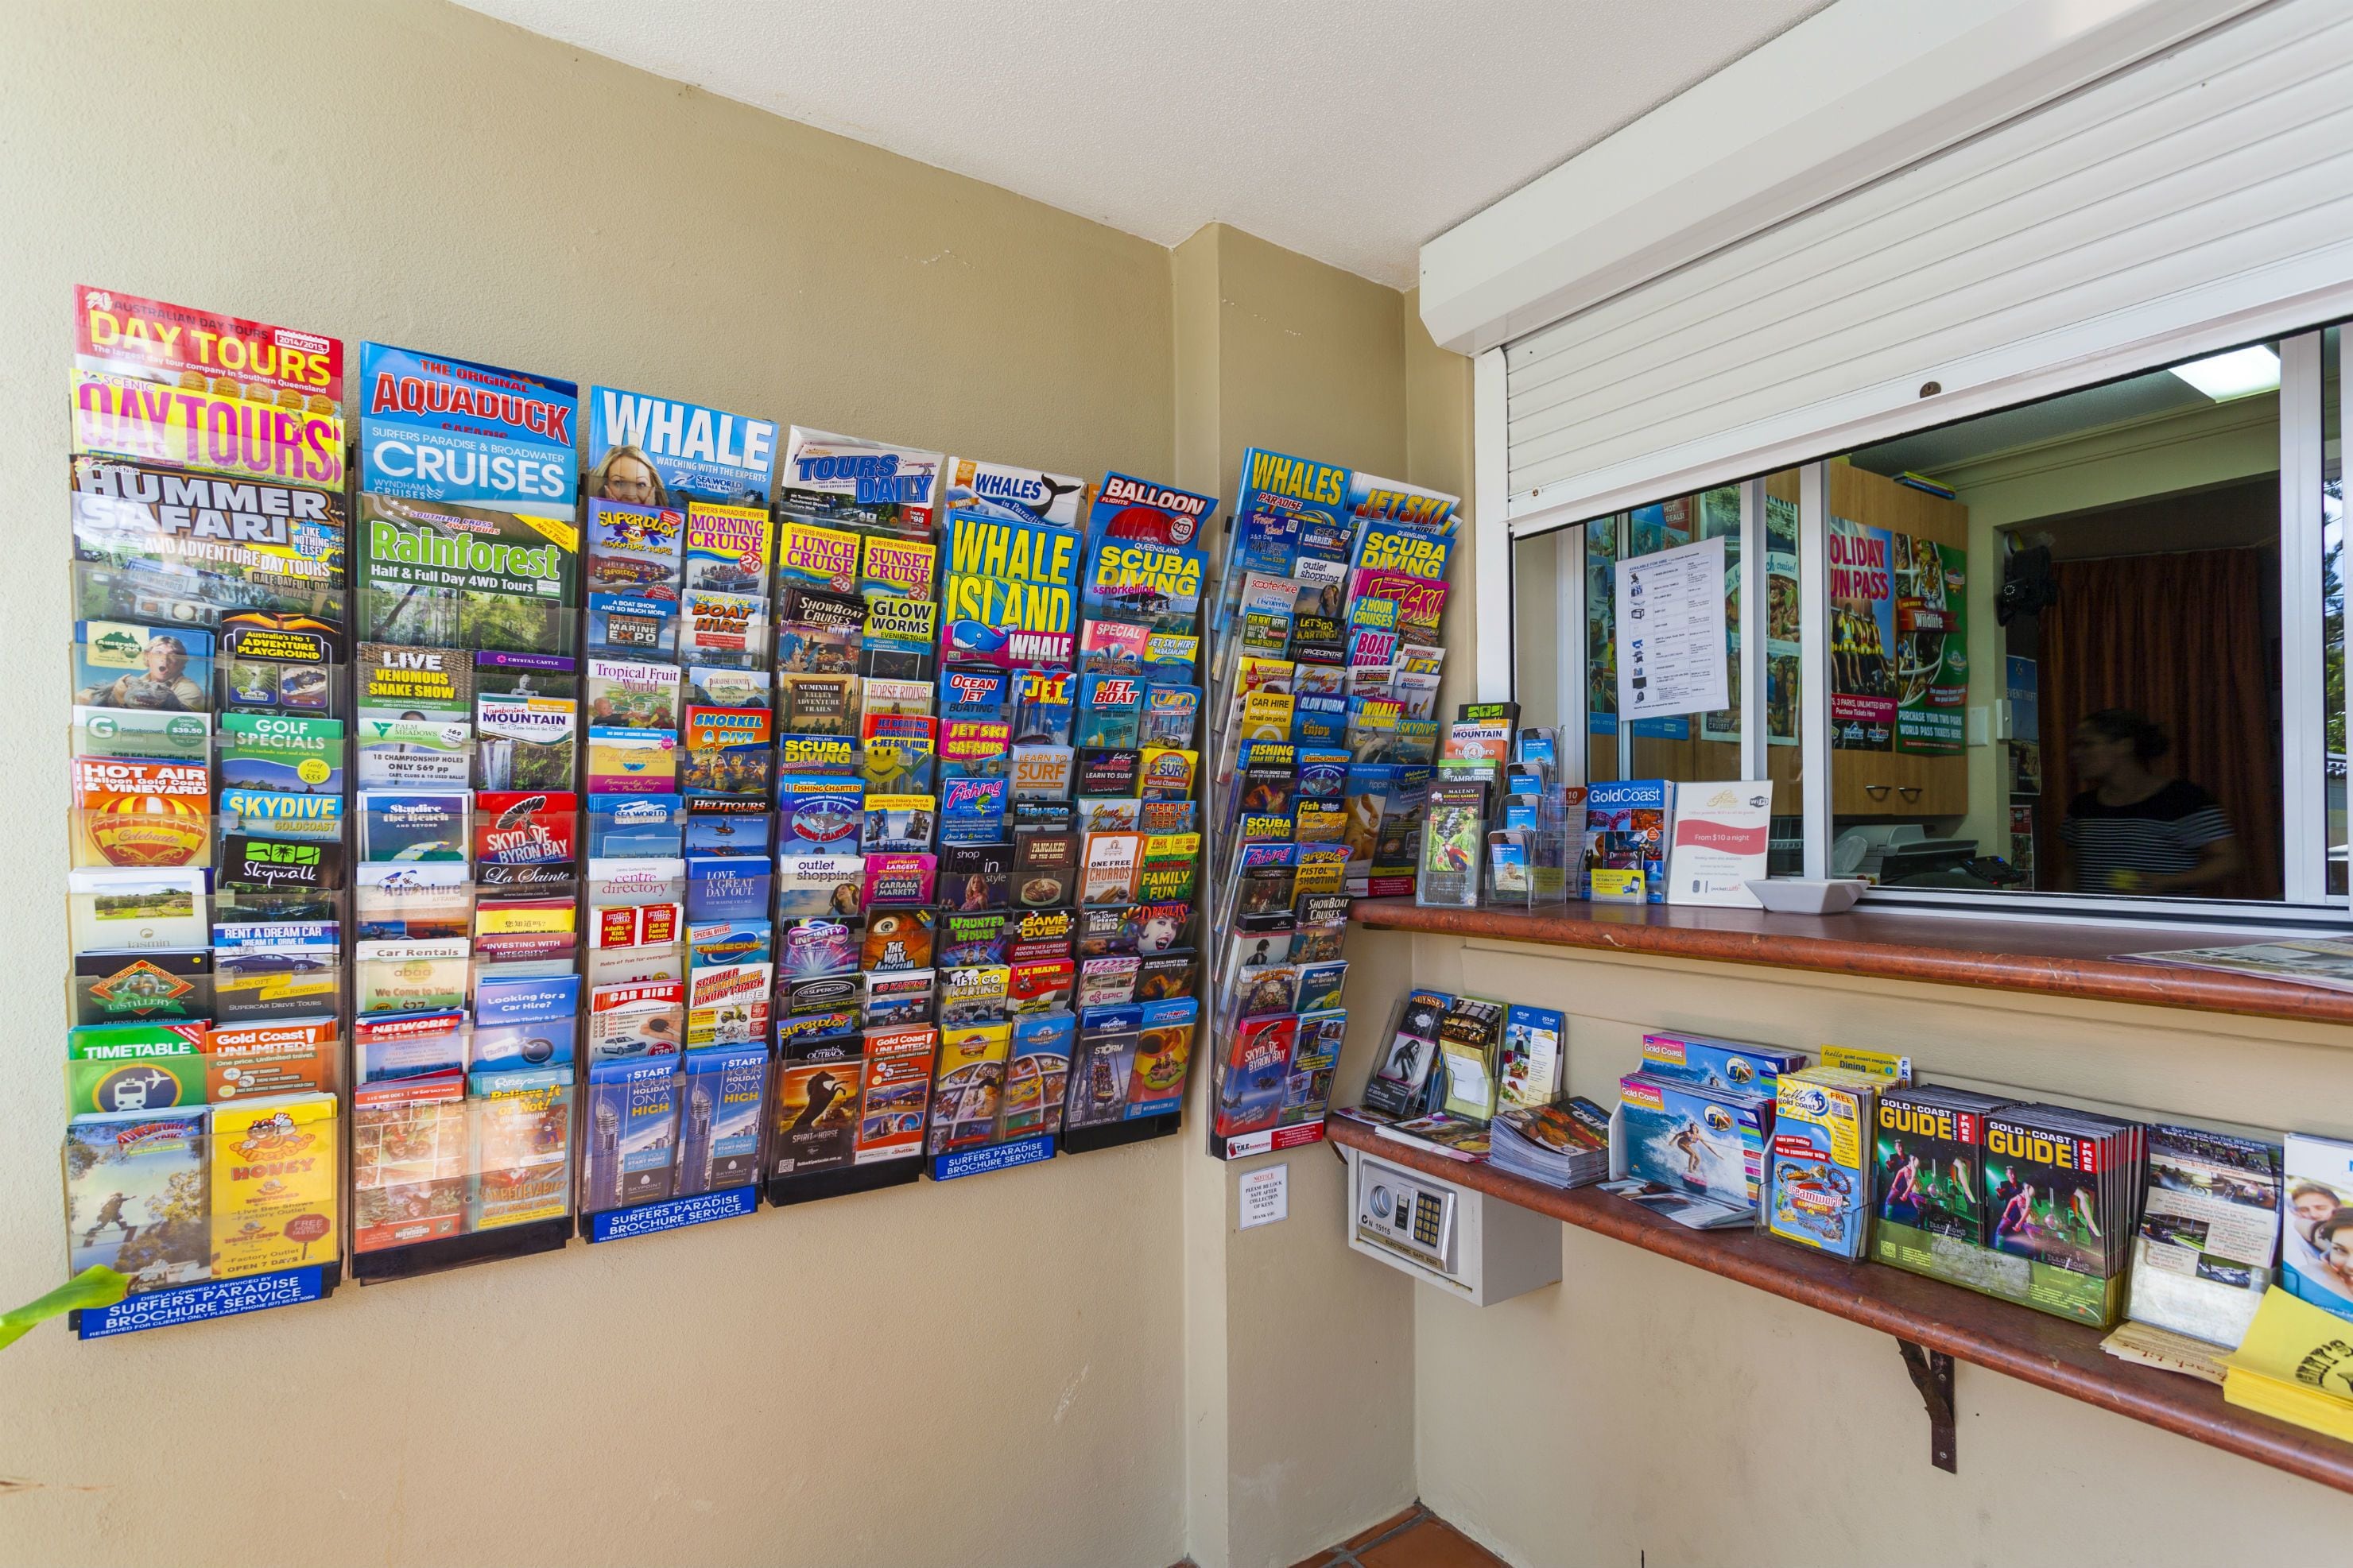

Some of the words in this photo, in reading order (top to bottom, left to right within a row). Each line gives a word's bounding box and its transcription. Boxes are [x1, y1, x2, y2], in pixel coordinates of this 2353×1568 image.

[89, 310, 182, 357] DAY
[191, 329, 331, 386] TOURS
[279, 335, 324, 350] 2014/2015
[93, 344, 110, 354] The
[165, 357, 184, 369] tour
[186, 362, 226, 377] company
[227, 367, 236, 376] in
[238, 370, 277, 385] Southern
[278, 379, 327, 394] Queensland
[420, 359, 452, 376] THE
[455, 368, 530, 393] ORIGINAL
[370, 371, 573, 449] AQUADUCK
[176, 393, 334, 482] TOURS
[603, 390, 773, 472] WHALE
[372, 427, 421, 443] SURFERS
[423, 435, 476, 451] PARADISE
[479, 443, 488, 452] &
[490, 445, 564, 464] BROADWATER
[373, 441, 565, 498] CRUISES
[656, 456, 696, 471] WATCHING
[698, 463, 718, 474] WITH
[719, 467, 734, 477] THE
[735, 470, 767, 482] EXPERTS
[797, 455, 899, 482] TOURS
[975, 473, 1043, 501] WHALES
[1252, 451, 1344, 506] WHALES
[85, 463, 328, 520] HUMMER
[857, 475, 934, 504] DAILY
[1106, 477, 1206, 515] BALLOON
[692, 505, 719, 514] SURFERS
[719, 508, 746, 517] PARADISE
[80, 498, 288, 544] SAFARI
[691, 514, 764, 536] MORNING
[301, 526, 321, 539] LIKE
[689, 530, 763, 552] CRUISE
[293, 535, 330, 549] NOTHING
[300, 544, 324, 556] ELSE!
[371, 520, 561, 580] Rainforest
[790, 533, 856, 559] LUNCH
[1135, 543, 1180, 555] QUEENSLAND
[1364, 532, 1446, 563] SCUBA
[178, 539, 259, 567] ADVENTURE
[261, 555, 285, 572] DAY
[286, 559, 331, 577] TOURS
[869, 548, 932, 570] SUNSET
[952, 519, 1074, 585] WHALE
[787, 550, 855, 575] CRUISE
[1099, 546, 1200, 578] SCUBA
[1360, 550, 1440, 579] DIVING
[370, 565, 399, 578] Half
[401, 568, 411, 579] &
[415, 569, 438, 582] Full
[441, 572, 465, 587] Day
[469, 575, 498, 588] 4WD
[502, 579, 533, 593] Tours
[866, 562, 930, 583] CRUISE
[1096, 566, 1197, 596] DIVING
[1853, 570, 1890, 600] PASS
[692, 603, 755, 619] BOAT
[873, 601, 932, 620] GLOW
[948, 575, 1071, 633] ISLAND
[694, 618, 749, 634] HIRE
[871, 618, 930, 633] WORMS
[1914, 611, 1944, 629] Wildlife
[1097, 623, 1141, 639] SPECIAL
[237, 646, 320, 660] PLAYGROUND
[242, 640, 316, 650] ADVENTURE
[383, 651, 442, 670] LIVE
[375, 669, 448, 685] VENOMOUS
[596, 664, 647, 679] Tropical
[650, 668, 677, 681] Fruit
[622, 679, 658, 693] World
[951, 674, 998, 690] OCEAN
[1105, 679, 1134, 692] JET
[369, 683, 412, 696] SNAKE
[415, 685, 455, 699] SHOW
[960, 688, 986, 703] JET
[1093, 691, 1139, 704] BOAT
[1252, 698, 1270, 707] CAR
[1271, 699, 1289, 708] HIRE
[255, 719, 308, 734] GOLF
[483, 713, 566, 725] MOUNTAIN
[694, 714, 763, 728] SNORKEL
[238, 732, 325, 749] SPECIALS
[702, 731, 715, 742] &
[719, 731, 755, 743] DIVE
[785, 740, 851, 753] SCUBA
[785, 752, 851, 764] DIVING
[83, 764, 147, 777] HOT
[160, 766, 207, 781] AIR
[1017, 763, 1068, 780] SURF
[1590, 788, 1660, 803] GoldCoast
[229, 796, 336, 819] SKYDIVE
[692, 799, 766, 812] HELITOURS
[799, 860, 835, 869] outlet
[244, 861, 316, 887] Skywalk
[483, 866, 514, 885] La
[517, 867, 570, 884] Sainte
[707, 871, 736, 880] LOVE
[797, 872, 855, 882] shopping
[1142, 871, 1190, 885] FAMILY
[1149, 886, 1177, 900] FUN
[225, 927, 252, 939] RENT
[255, 928, 262, 937] A
[264, 927, 299, 938] DREAM
[301, 927, 322, 937] CAR
[406, 948, 459, 957] Rentals
[611, 989, 638, 1001] CAR
[642, 987, 673, 998] HIRE
[216, 1033, 263, 1046] Gold
[266, 1030, 305, 1043] Coast
[83, 1042, 191, 1059] TIMETABLE
[1644, 1044, 1660, 1053] Gold
[1661, 1047, 1683, 1058] Coast
[634, 1067, 672, 1078] START
[1839, 1060, 1866, 1073] Dining
[1830, 1092, 1852, 1104] FREE
[632, 1103, 669, 1117] HIGH
[1881, 1098, 1910, 1109] GOLD
[1917, 1105, 1951, 1117] COAST
[1879, 1107, 1952, 1141] GUIDE
[1990, 1121, 2025, 1135] GOLD
[2032, 1130, 2072, 1144] COAST
[1987, 1130, 2072, 1169] GUIDE
[1376, 1224, 1390, 1235] 15115
[1386, 1240, 1411, 1254] ELECTRONIC
[109, 1294, 195, 1318] SURFERS
[203, 1276, 299, 1301] PARADISE
[106, 1303, 216, 1330] BROCHURE
[219, 1287, 302, 1313] SERVICE
